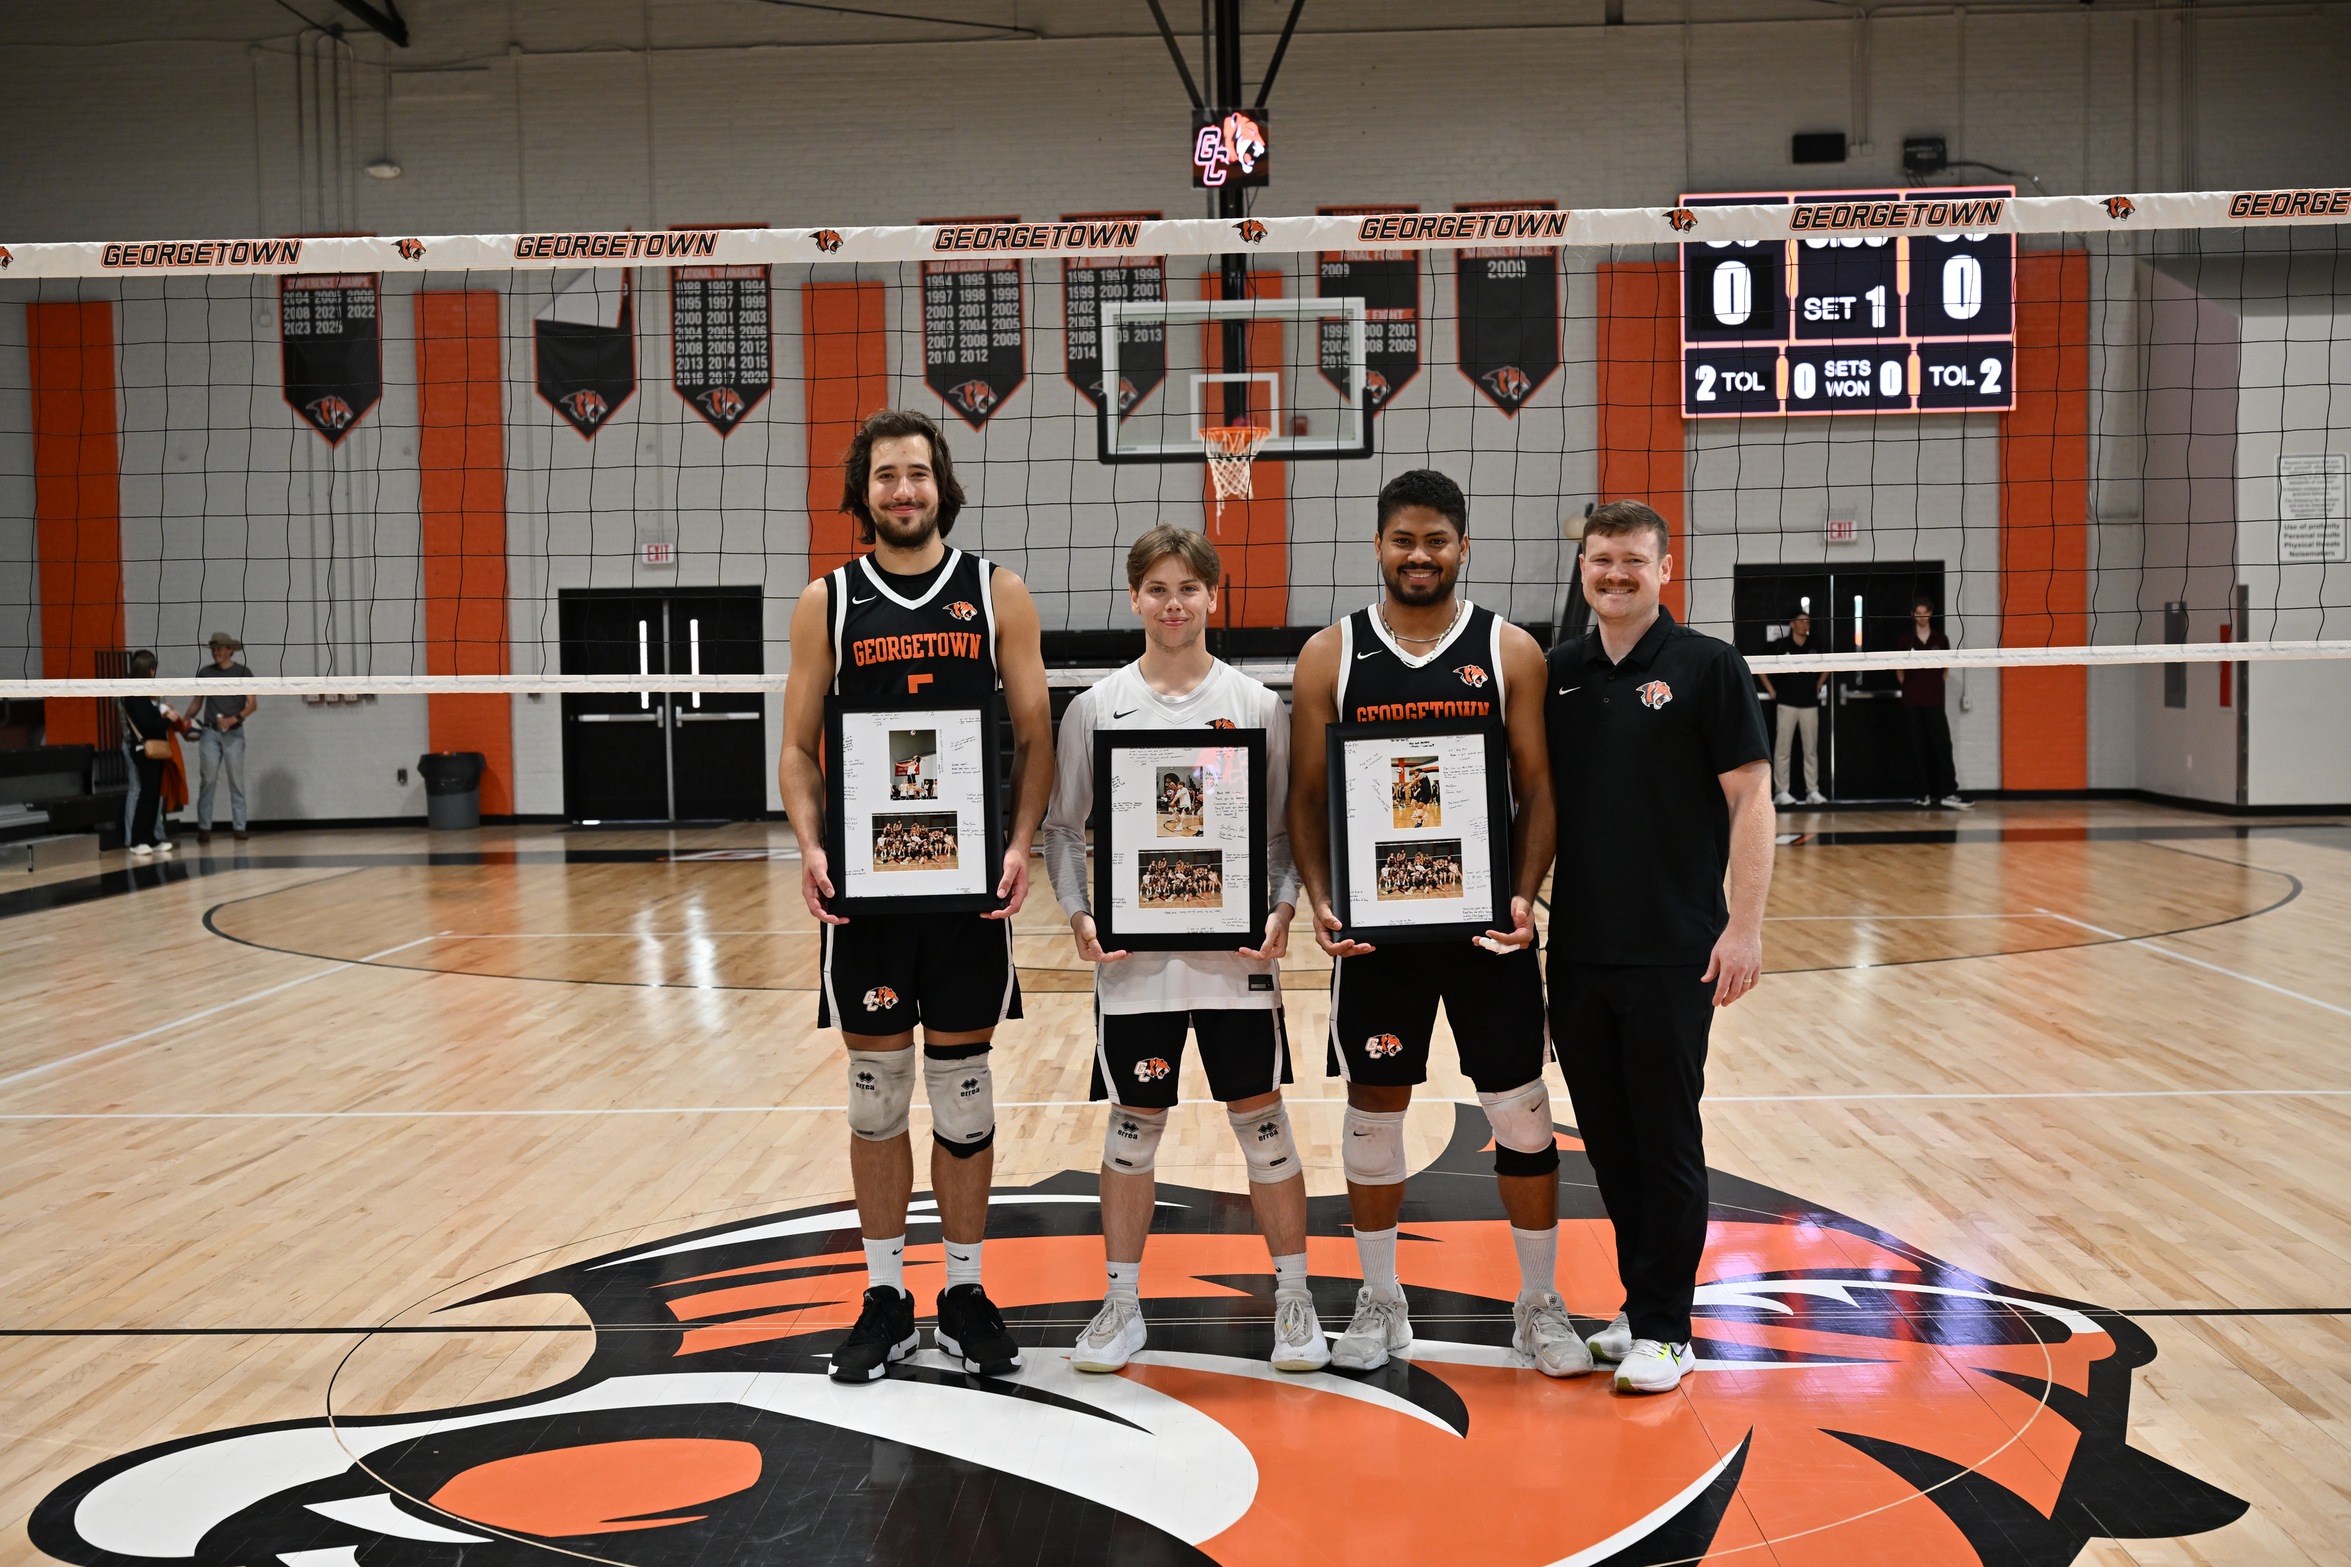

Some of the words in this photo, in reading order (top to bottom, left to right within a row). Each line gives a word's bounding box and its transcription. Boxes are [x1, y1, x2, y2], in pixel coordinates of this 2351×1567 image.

[1790, 199, 2004, 231] GEORGETOWN
[1358, 211, 1570, 241] GEORGETOWN
[515, 231, 720, 259] GEORGETOWN
[933, 222, 1141, 252] GEORGETOWN
[101, 239, 302, 268] GEORGETOWN
[1068, 271, 1094, 283] 1996
[1101, 270, 1127, 283] 1997
[926, 290, 952, 304] 1997
[959, 289, 986, 302] 1998
[992, 287, 1019, 301] 1999
[1068, 286, 1095, 299] 1999
[1100, 285, 1128, 298] 2000
[1133, 283, 1160, 297] 2001
[1713, 261, 1752, 325] 0
[1943, 254, 1982, 320] 0
[675, 297, 702, 310] 1995
[708, 296, 733, 309] 1997
[740, 295, 766, 309] 1999
[926, 305, 954, 319] 2000
[959, 304, 986, 317] 2001
[992, 302, 1019, 316] 2002
[1804, 296, 1857, 321] SET
[1865, 285, 1886, 328] 1
[283, 306, 310, 320] 2008
[347, 304, 375, 318] 2022
[675, 312, 702, 325] 2000
[707, 311, 734, 324] 2001
[739, 310, 766, 324] 2003
[1134, 328, 1162, 342] 2013
[1388, 323, 1415, 337] 2001
[707, 341, 735, 355] 2009
[739, 340, 767, 354] 2012
[960, 334, 988, 348] 2008
[992, 333, 1021, 346] 2009
[1388, 339, 1416, 352] 2009
[708, 356, 736, 370] 2014
[740, 355, 768, 369] 2015
[960, 349, 988, 363] 2012
[1824, 360, 1871, 378] SETS
[1879, 360, 1902, 396] 0
[1929, 365, 1975, 386] TOL
[1980, 358, 2002, 394] 2
[1695, 365, 1716, 401] 2
[1721, 372, 1766, 393] TOL
[1793, 362, 1816, 399] 0
[1825, 380, 1870, 397] WON
[1830, 521, 1853, 539] EXIT
[647, 544, 669, 562] EXIT
[853, 632, 981, 667] GEORGETOWN
